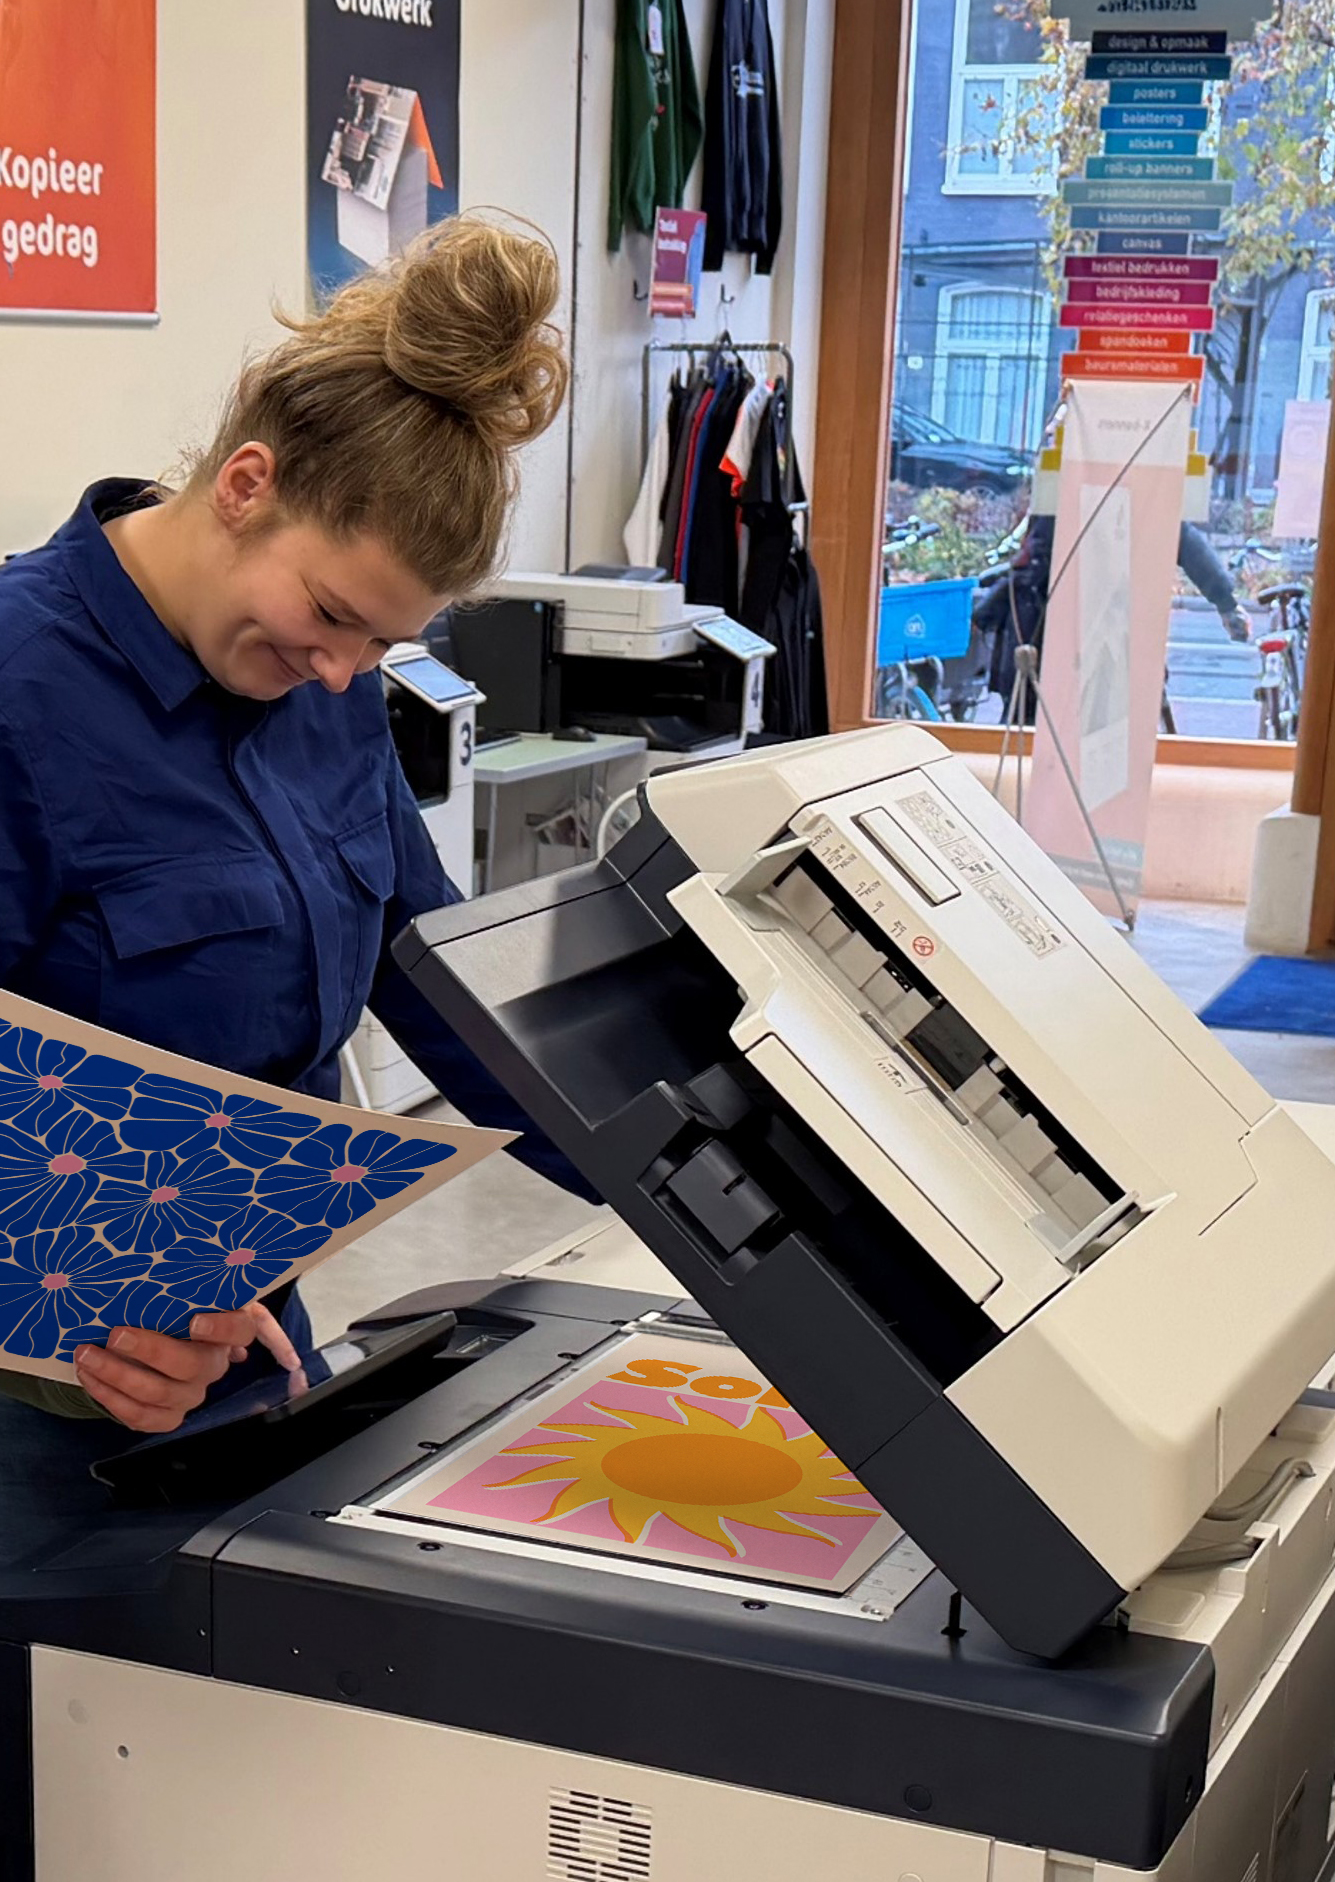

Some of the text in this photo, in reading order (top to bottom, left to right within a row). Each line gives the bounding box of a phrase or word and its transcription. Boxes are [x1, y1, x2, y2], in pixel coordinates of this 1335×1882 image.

[1108, 35, 1209, 50] design & opmaak
[1106, 60, 1207, 75] digitaal drukwerk
[1133, 87, 1176, 100] posters
[1122, 111, 1184, 126] belettering
[1129, 136, 1174, 149] stickers
[1104, 163, 1194, 176] roll-up banners
[1098, 211, 1191, 225] kantoorartikelen
[2, 212, 98, 267] gedrag
[1122, 238, 1162, 249] canvas
[1092, 261, 1190, 274] textiel bedrukken
[1096, 286, 1180, 302] bedrijfskleding
[1084, 311, 1187, 325] relatiegeschenken
[1100, 336, 1168, 348] spandoeken
[1085, 359, 1178, 373] beursmaterialen
[750, 673, 760, 707] 4
[460, 722, 471, 766] 3
